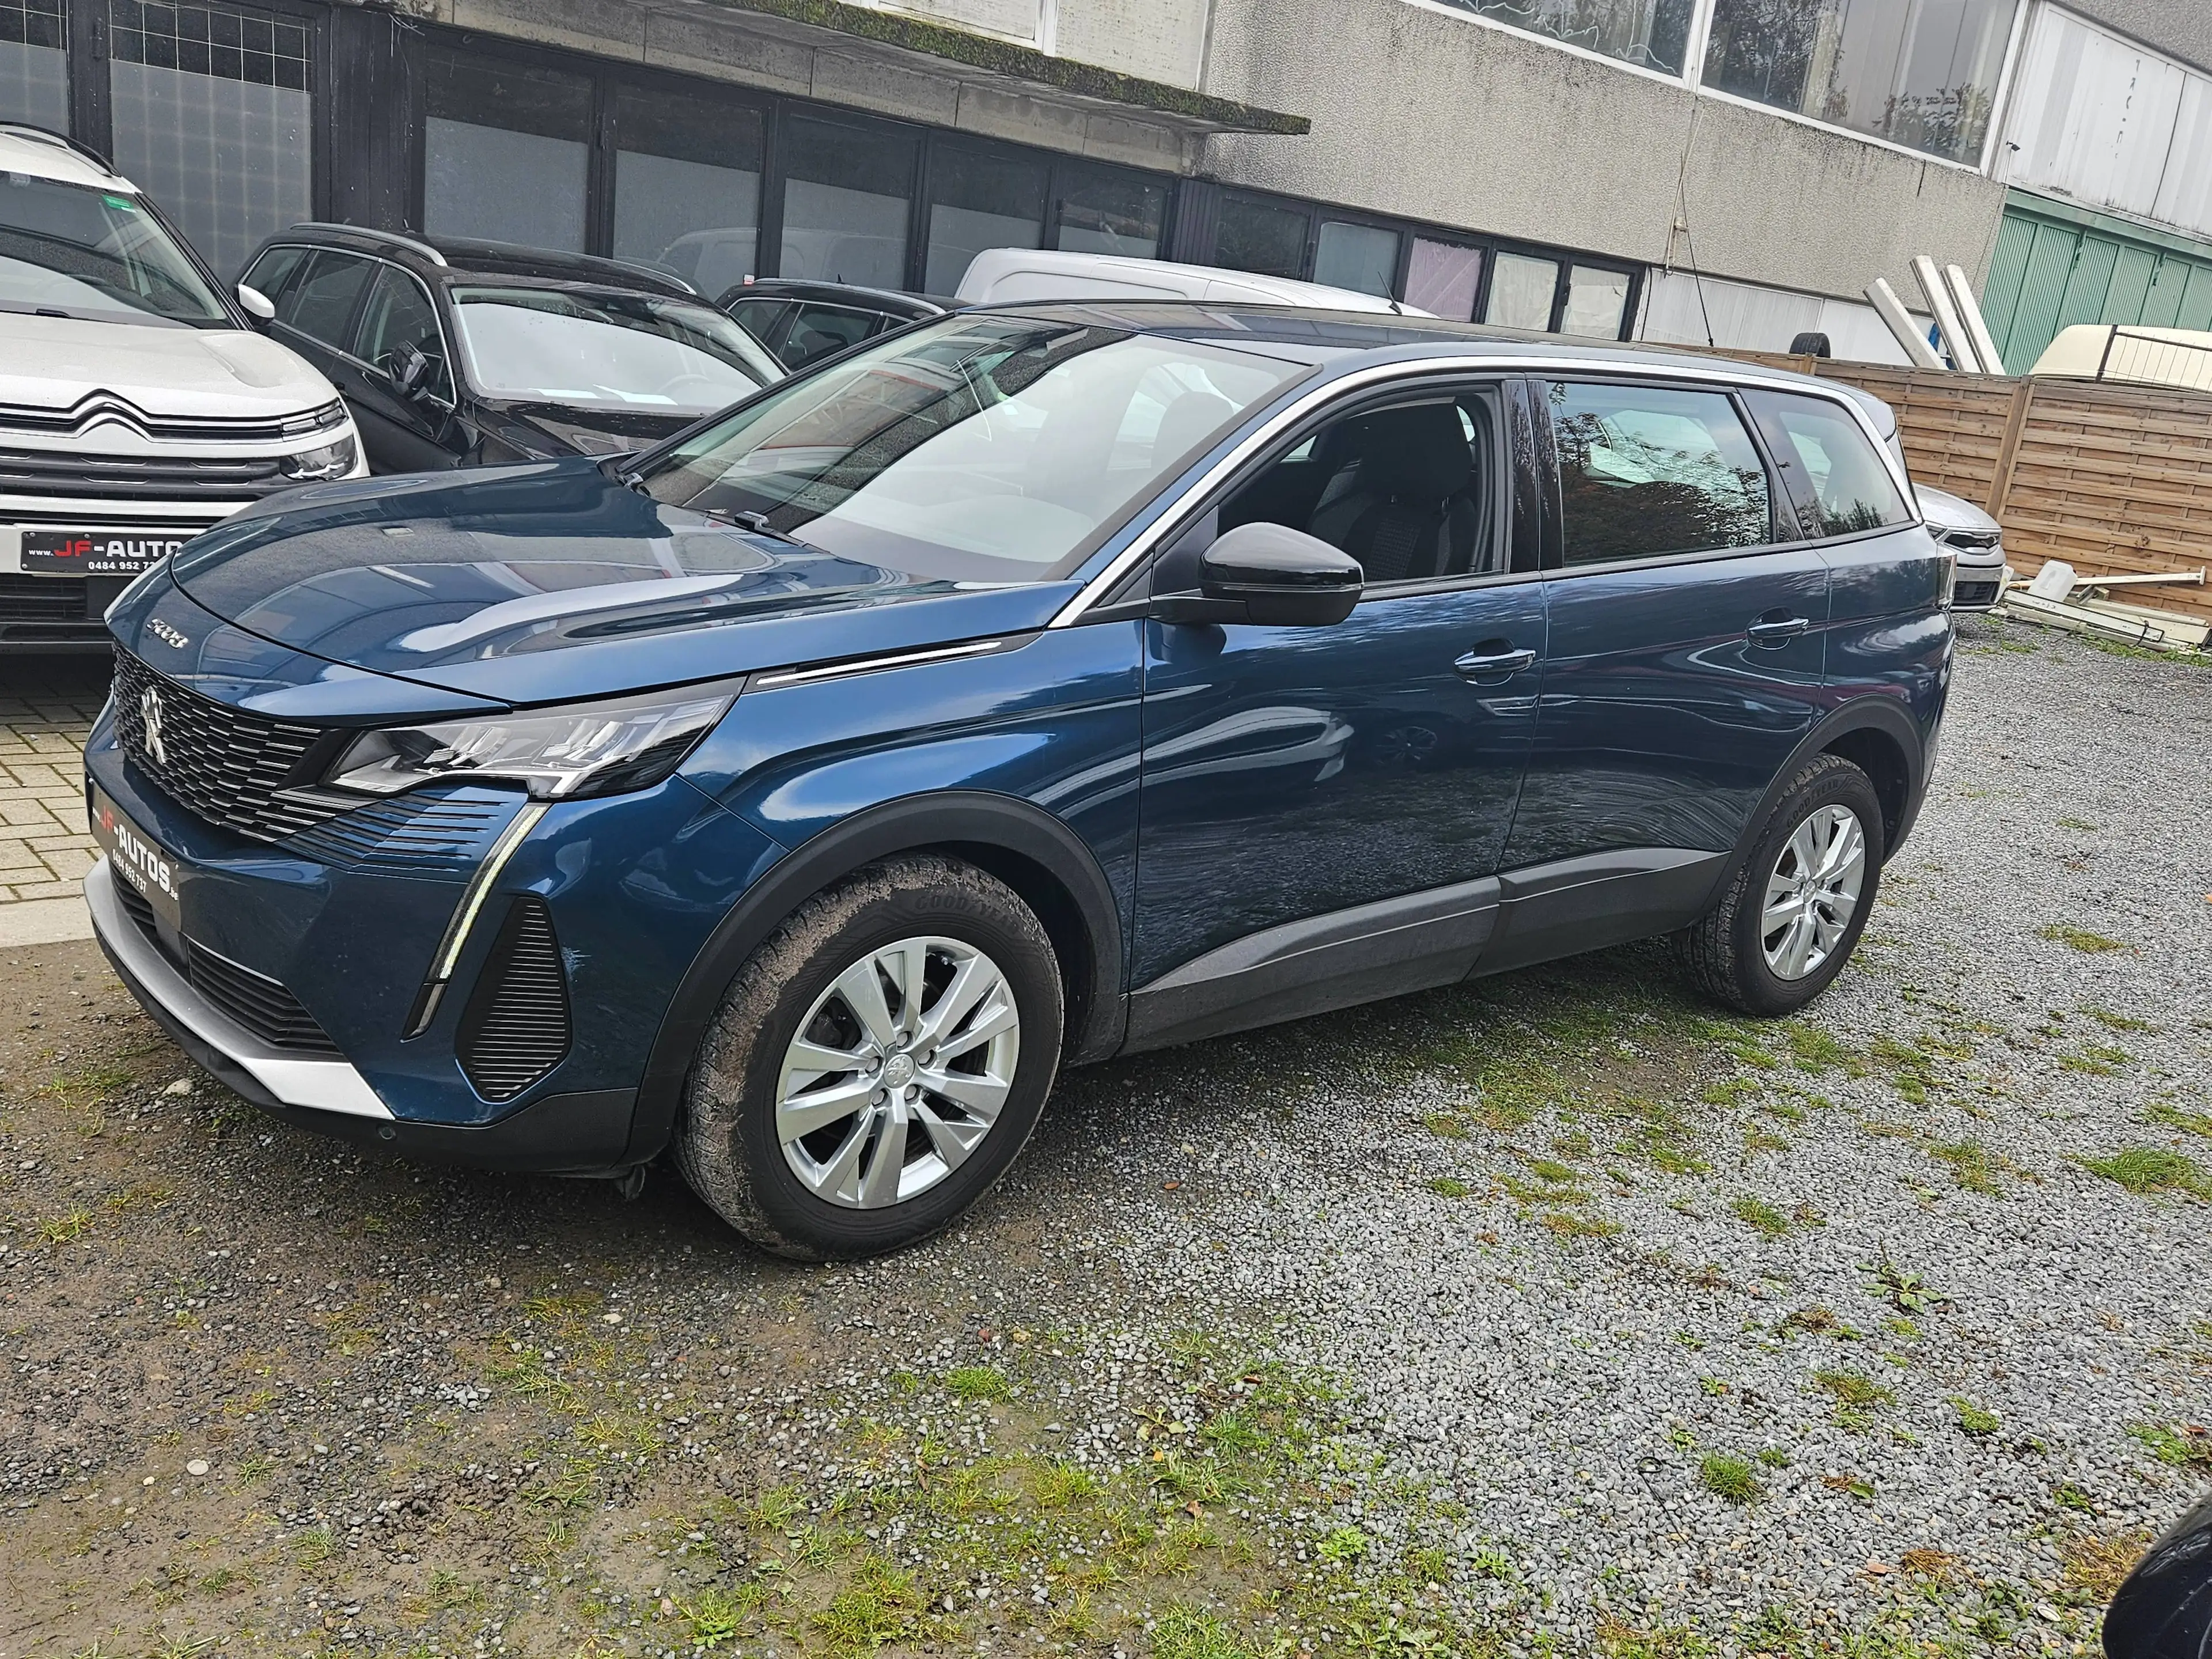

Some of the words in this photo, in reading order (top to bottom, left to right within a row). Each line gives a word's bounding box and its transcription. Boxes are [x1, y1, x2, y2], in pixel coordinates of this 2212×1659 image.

[88, 562, 116, 570] 0484
[119, 562, 139, 570] 952
[146, 618, 189, 648] 5008
